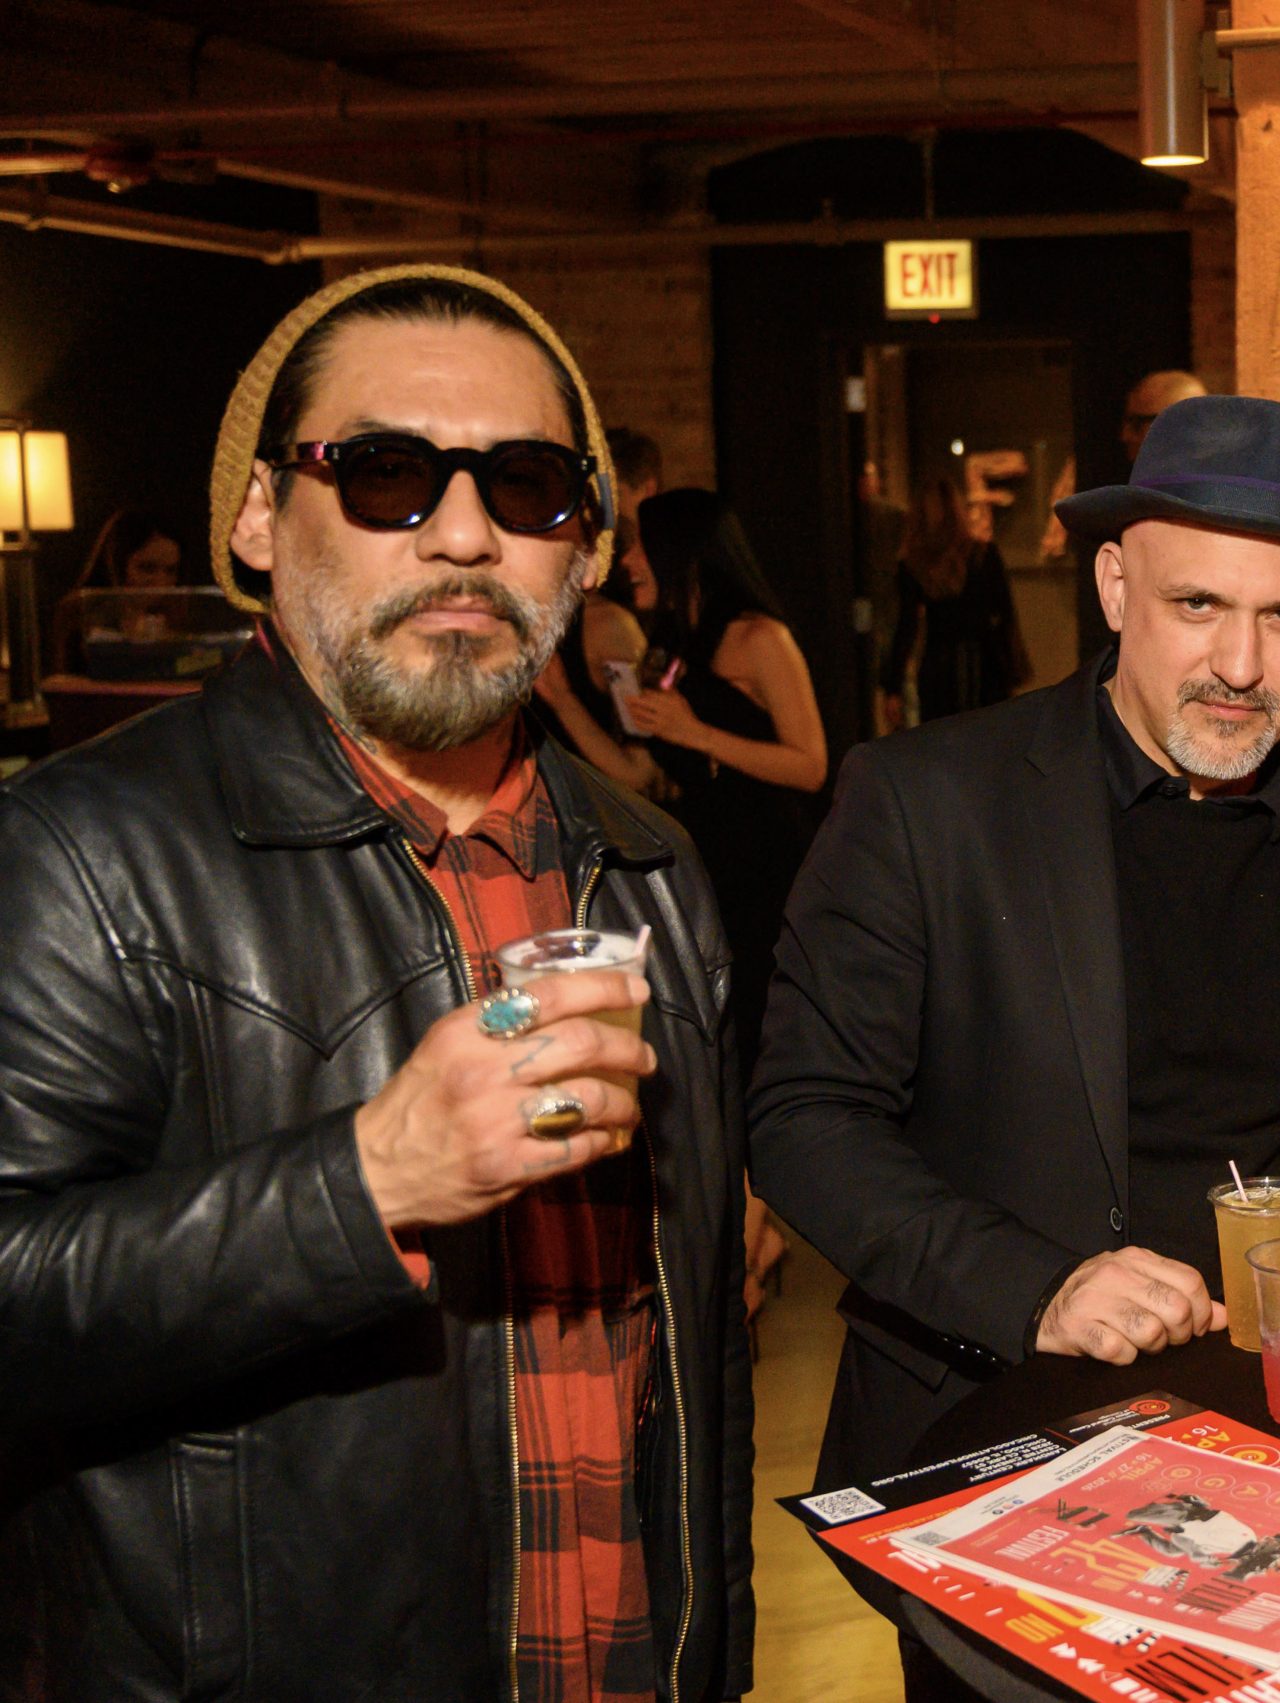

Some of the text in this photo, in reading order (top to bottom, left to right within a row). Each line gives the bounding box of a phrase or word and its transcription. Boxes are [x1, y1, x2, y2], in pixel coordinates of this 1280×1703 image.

[901, 253, 958, 298] EXIT
[979, 1444, 1060, 1472] CENTRE CINEMAS
[1013, 1446, 1067, 1467] LANDMARK
[1056, 1454, 1101, 1482] SCHEDULE
[1118, 1457, 1163, 1480] APRIL
[969, 1464, 1014, 1482] CENTURY
[994, 1524, 1071, 1562] FESTIVAL
[1176, 1577, 1257, 1614] FILM
[1124, 1645, 1264, 1703] ILM
